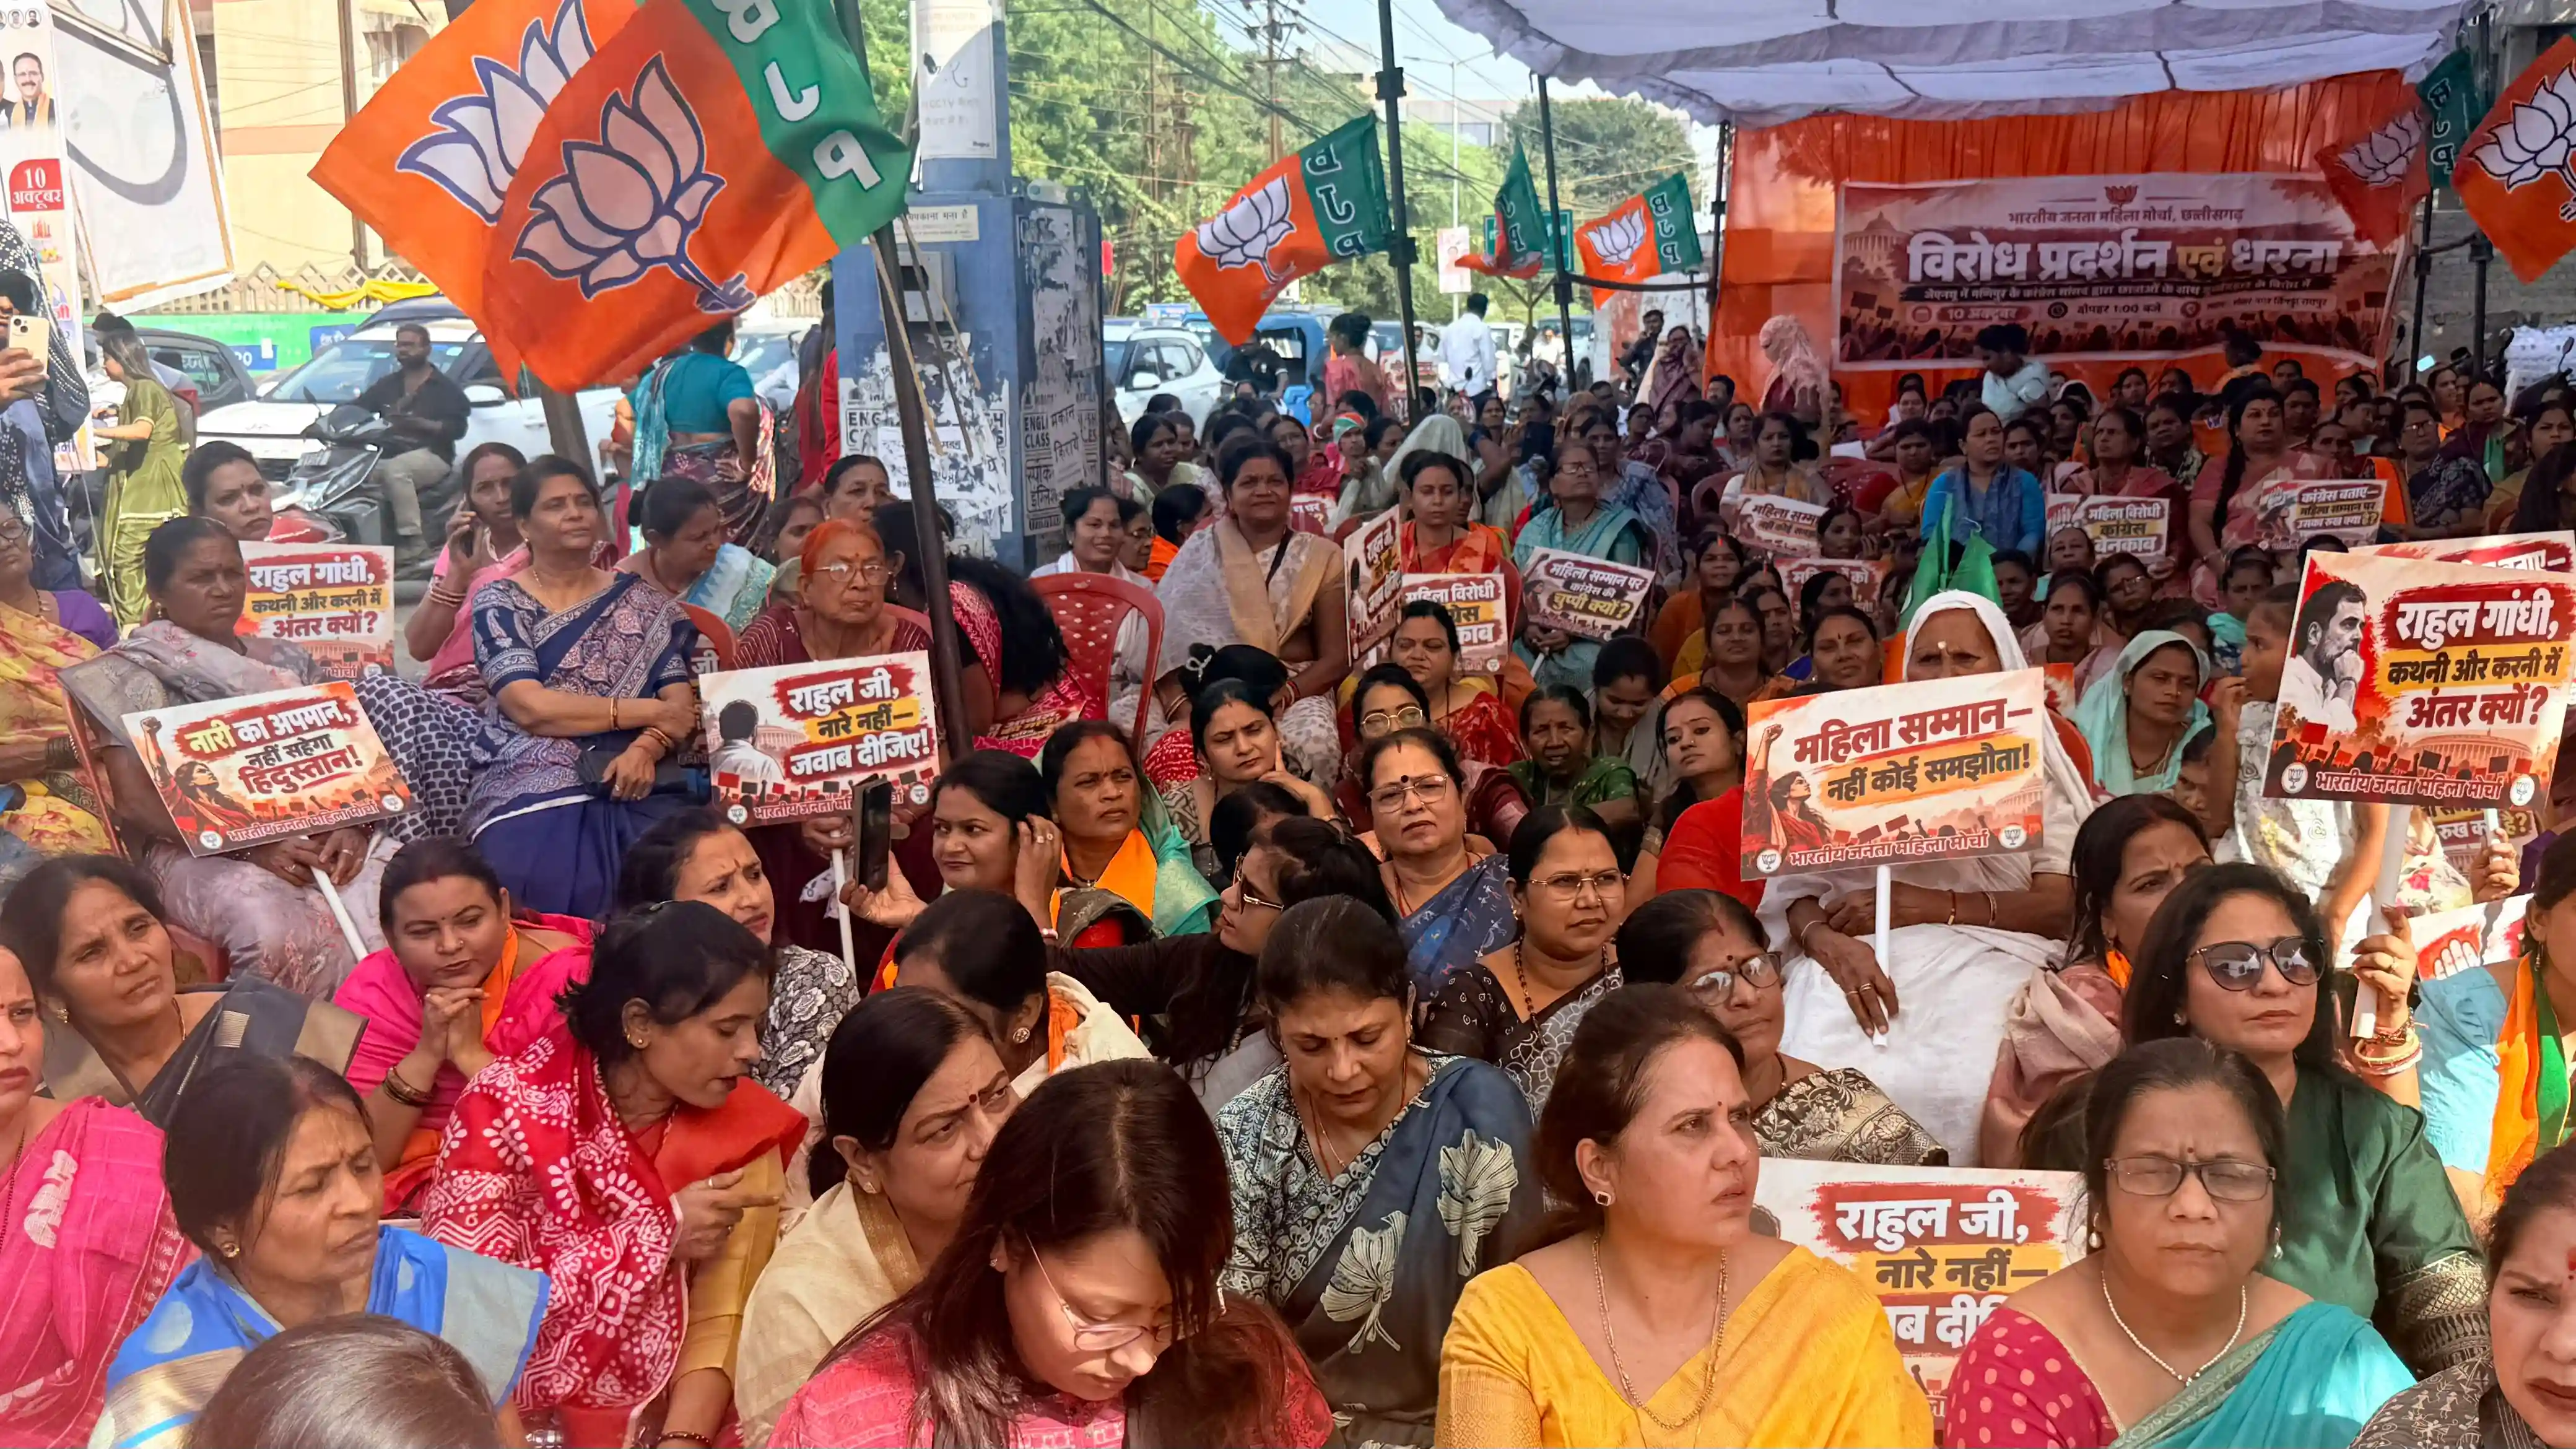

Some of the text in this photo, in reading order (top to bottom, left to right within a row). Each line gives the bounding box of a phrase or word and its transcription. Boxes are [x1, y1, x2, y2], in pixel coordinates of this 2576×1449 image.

[24, 166, 46, 189] 10
[2009, 208, 2057, 224] भारतीय
[2060, 210, 2097, 224] जनता
[2099, 207, 2139, 224] महिला
[1907, 227, 2343, 283] विरोध प्रदर्शन एवं धरना
[1949, 308, 1965, 319] 10
[1752, 502, 1790, 521] महिला
[2088, 502, 2162, 521] महिला विरोधी
[2301, 488, 2337, 504] कांग्रेस
[2100, 520, 2147, 536] कांग्रेस
[250, 554, 375, 593] राहुल गांधी,
[1549, 561, 1645, 590] महिला सम्मान पर
[252, 588, 382, 613] कथनी और करनी में
[1451, 580, 1495, 600] विरोधी
[1569, 581, 1617, 598] कांग्रेस की
[1552, 592, 1630, 619] चुप्पी क्यों?
[2395, 588, 2558, 651] राहुल गांधी,
[272, 609, 378, 638] अंतर क्यों?
[2387, 646, 2564, 685] कथनी और करनी में
[787, 668, 900, 716] राहुल जी,
[2406, 682, 2549, 728] अंतर क्यों?
[184, 701, 352, 754] नारी का अपमान,
[817, 711, 852, 739] नारे
[245, 733, 335, 768] नहीं सहेगा
[790, 728, 930, 777] जवाब दीजिए!
[1794, 718, 1893, 765] महिला
[1827, 741, 2030, 802] नहीं कोई समझौता!
[2315, 767, 2505, 800] भारतीय जनता महिला मोर्चा
[227, 799, 380, 842] भारतीय जनता महिला मोर्चा
[753, 800, 799, 819] भारतीय
[799, 799, 833, 816] जनता
[2437, 822, 2469, 840] रुख
[1789, 827, 1990, 867] भारतीय जनता महिला मोर्चा
[1835, 1188, 2029, 1254] राहुल जी,
[1875, 1247, 1938, 1290] नारे
